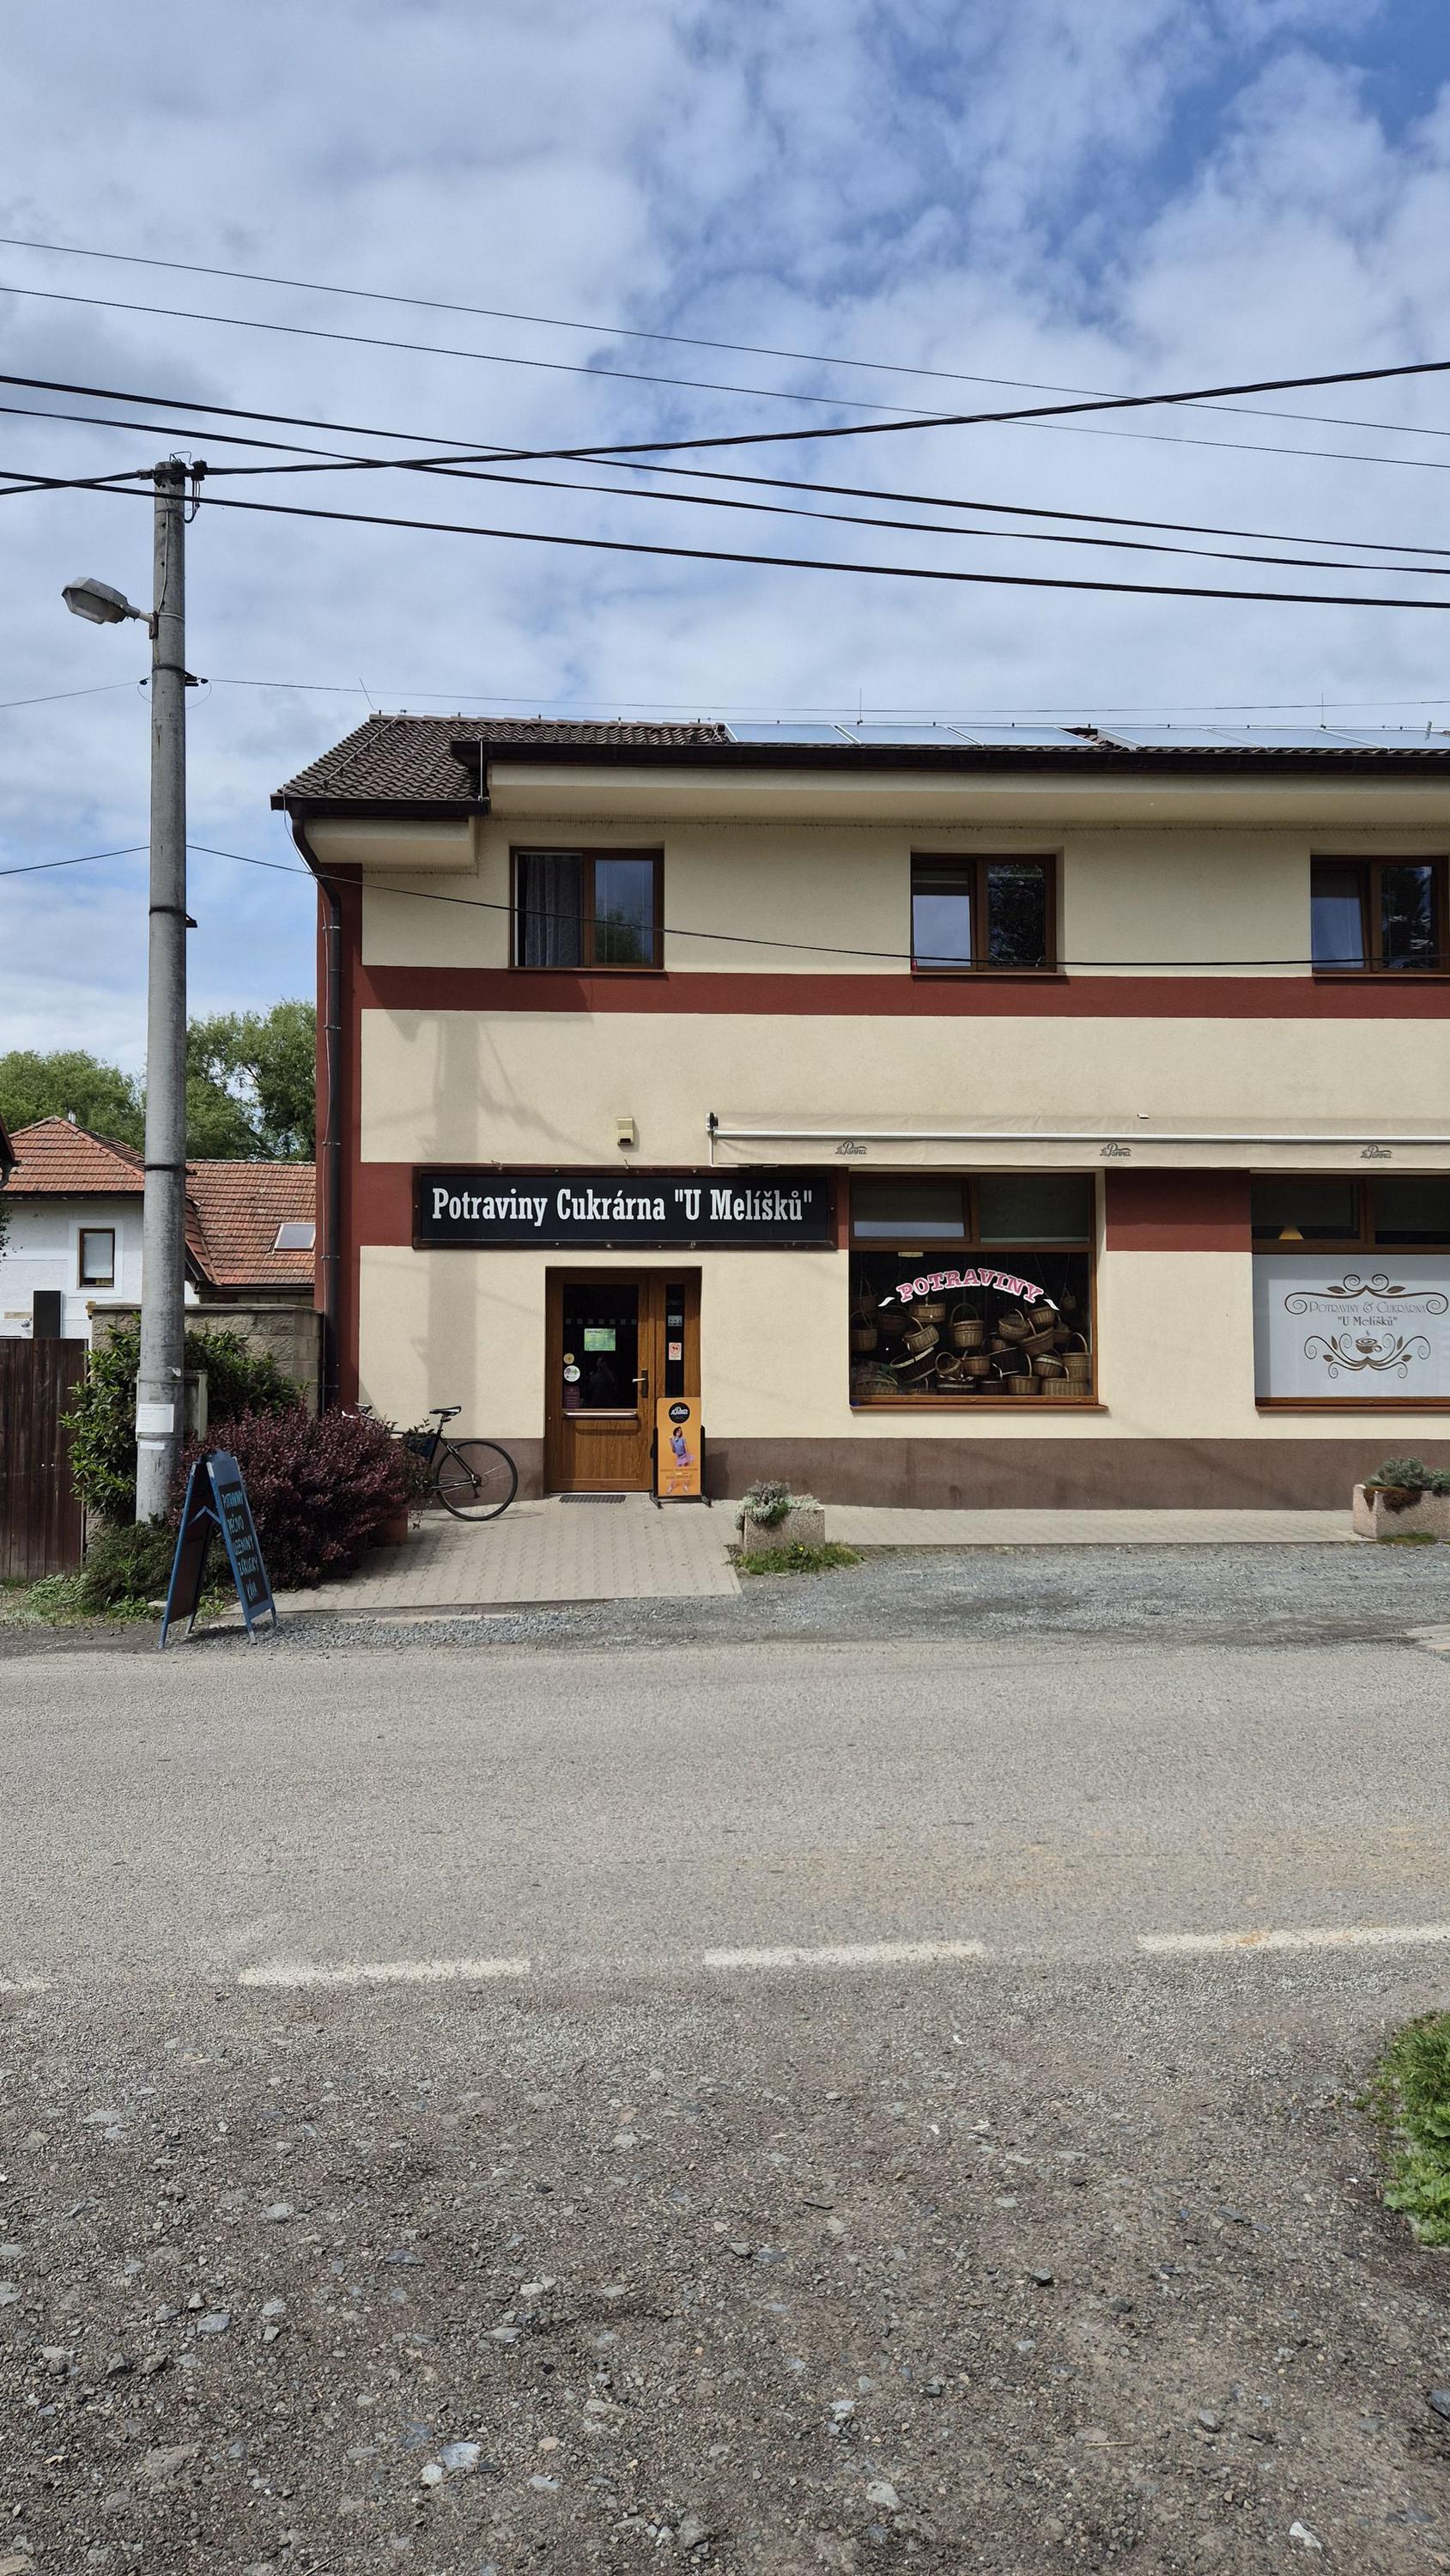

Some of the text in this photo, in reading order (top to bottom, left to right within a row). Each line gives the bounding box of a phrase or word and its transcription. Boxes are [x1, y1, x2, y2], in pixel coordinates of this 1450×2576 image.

[432, 1188, 813, 1226] Potraviny Cukrárna "U Melíšků"
[895, 1267, 1045, 1303] POTRAVINY
[1362, 1301, 1374, 1313] &
[1338, 1316, 1349, 1327] "U
